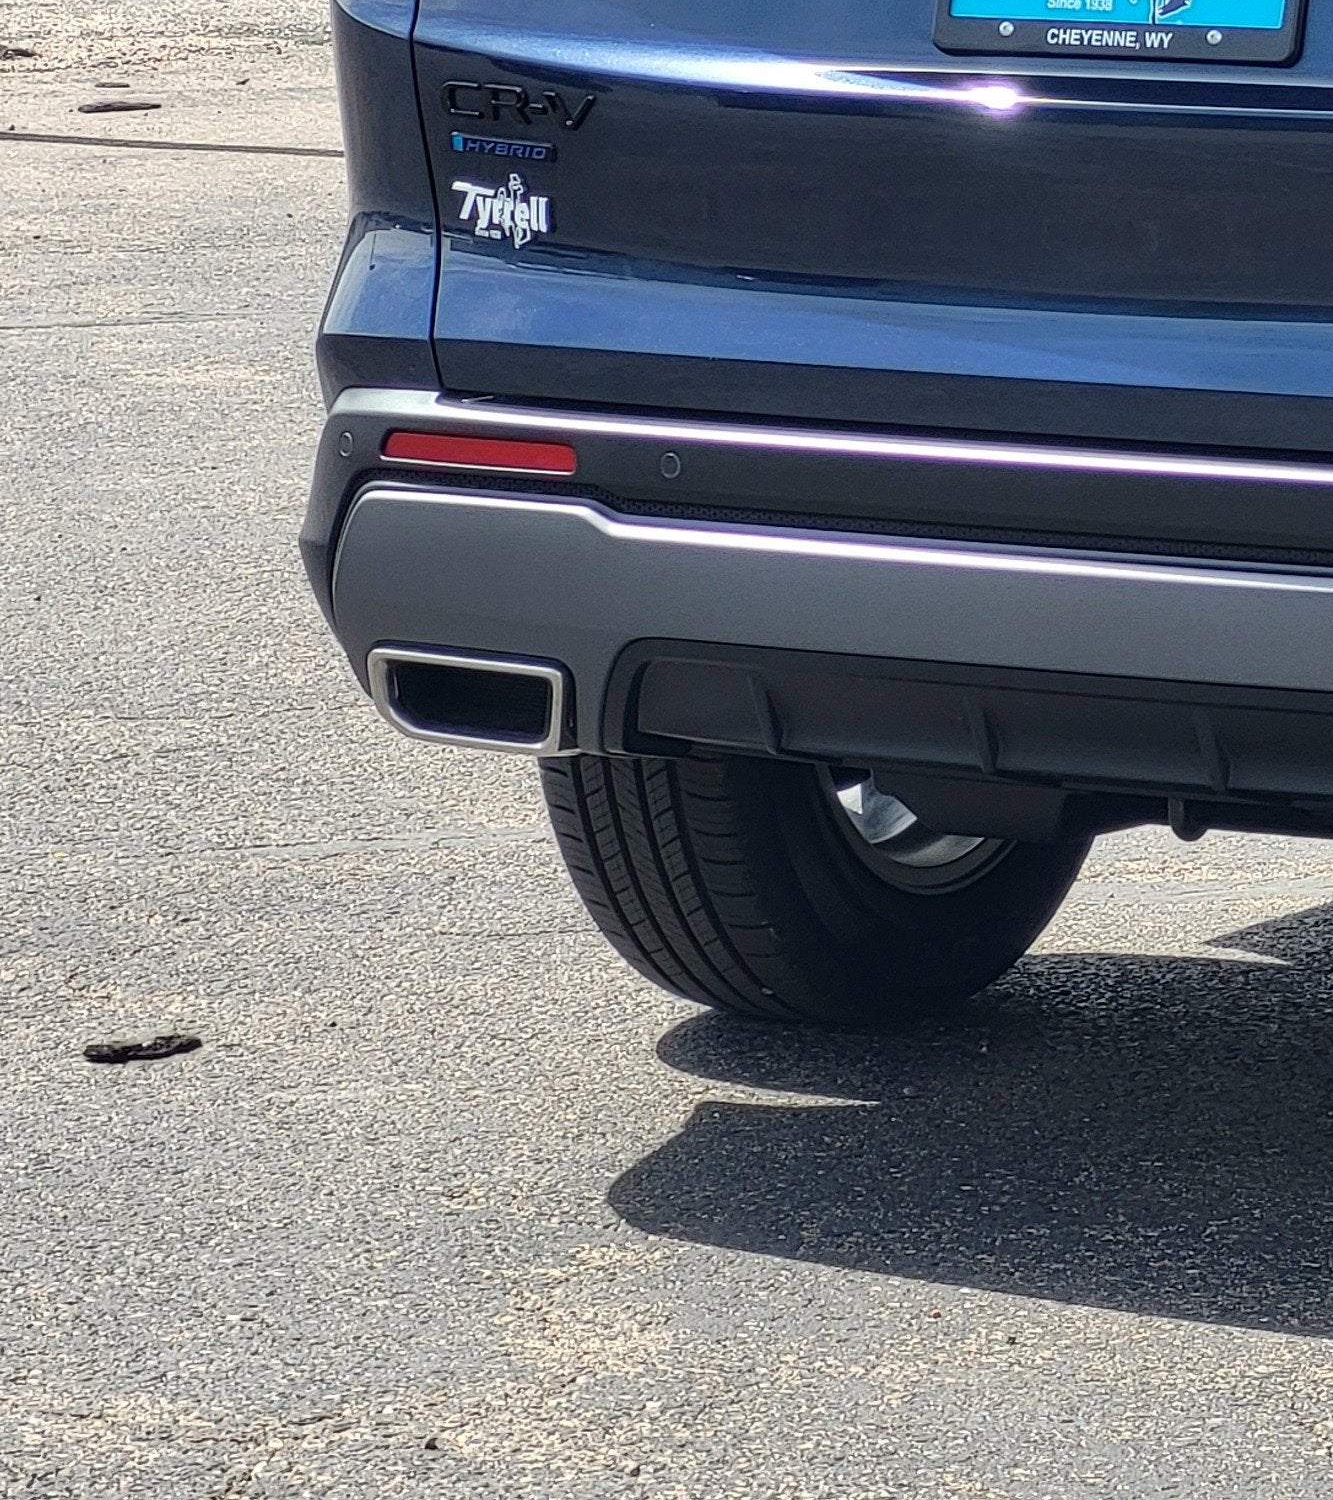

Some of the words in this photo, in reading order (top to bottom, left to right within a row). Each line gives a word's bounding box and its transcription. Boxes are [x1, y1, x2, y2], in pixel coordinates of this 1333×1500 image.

[1046, 27, 1141, 51] CHEYENNE,
[1143, 30, 1174, 50] WY
[440, 78, 598, 131] CR-V
[464, 139, 548, 160] HYBRID
[450, 180, 550, 234] Tyrrell
